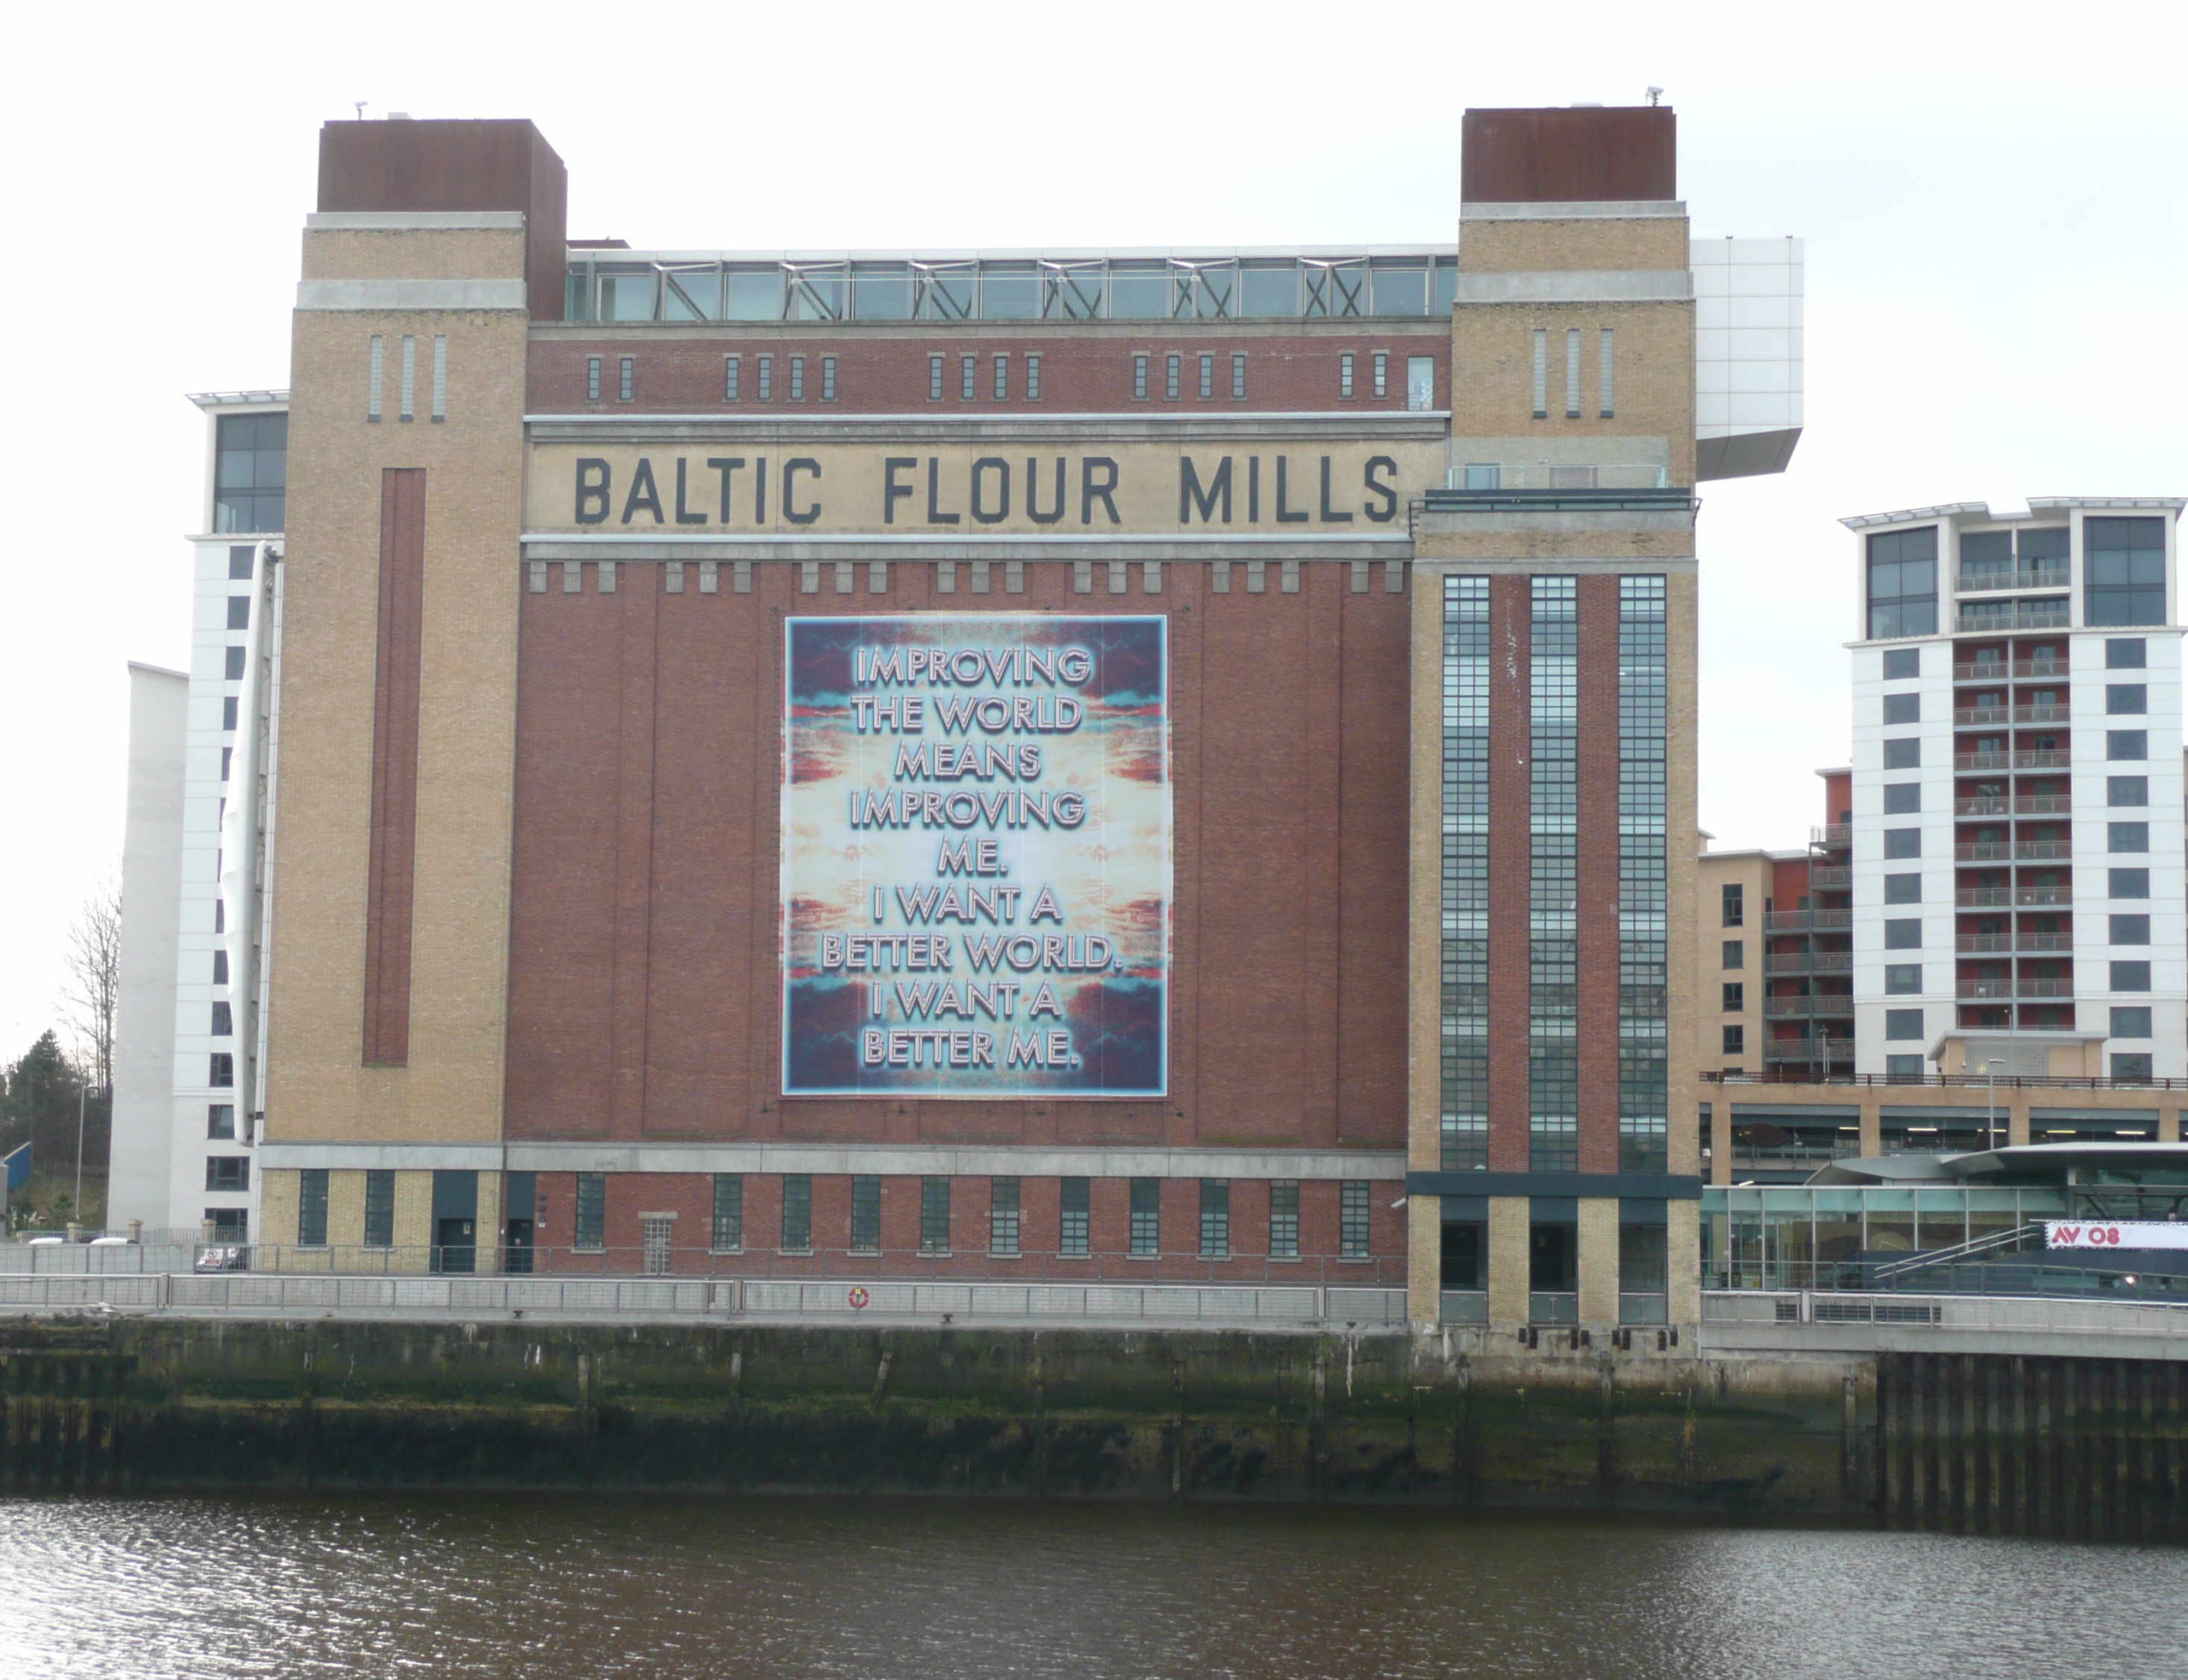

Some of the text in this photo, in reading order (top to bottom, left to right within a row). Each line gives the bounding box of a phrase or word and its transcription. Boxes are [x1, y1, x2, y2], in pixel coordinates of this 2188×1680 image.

[573, 455, 1398, 524] BALTIC FLOUR MILLS
[856, 647, 1091, 683] IMPROVING
[851, 694, 1081, 731] THE WORLD
[895, 741, 1041, 781] MEANS
[850, 790, 1085, 829] IMPROVING
[938, 837, 1008, 875] ME.
[873, 884, 1062, 922] I WANT A
[821, 932, 1122, 969] BETTER WORLD.
[872, 979, 1062, 1018] I WANT A
[863, 1029, 1080, 1067] BETTER ME.
[2052, 1227, 2081, 1244] AV
